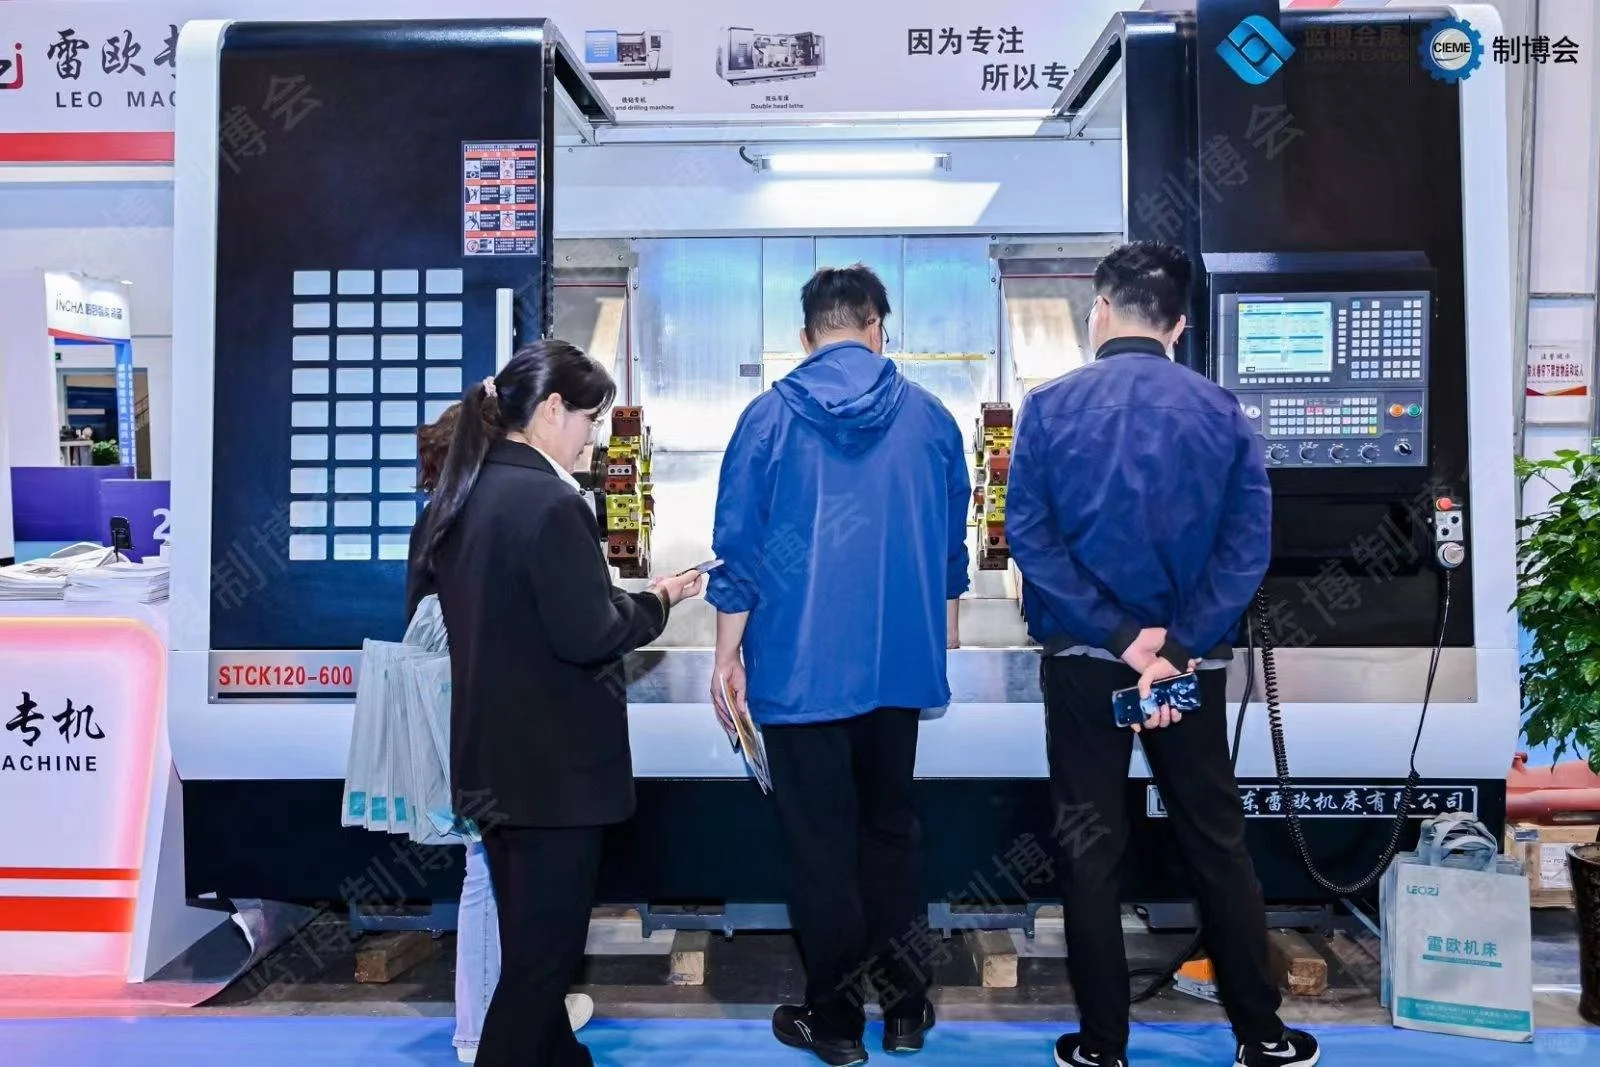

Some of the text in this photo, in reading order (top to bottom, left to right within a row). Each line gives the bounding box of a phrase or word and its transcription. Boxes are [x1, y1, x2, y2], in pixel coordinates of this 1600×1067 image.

[907, 26, 1024, 55] 因为专注
[56, 91, 103, 108] LEO
[628, 104, 649, 112] drilling
[218, 665, 353, 687] STCK120-600
[5, 691, 106, 747] 专机
[1, 755, 98, 772] ACHINE
[1425, 935, 1498, 957] 雷欧机床
